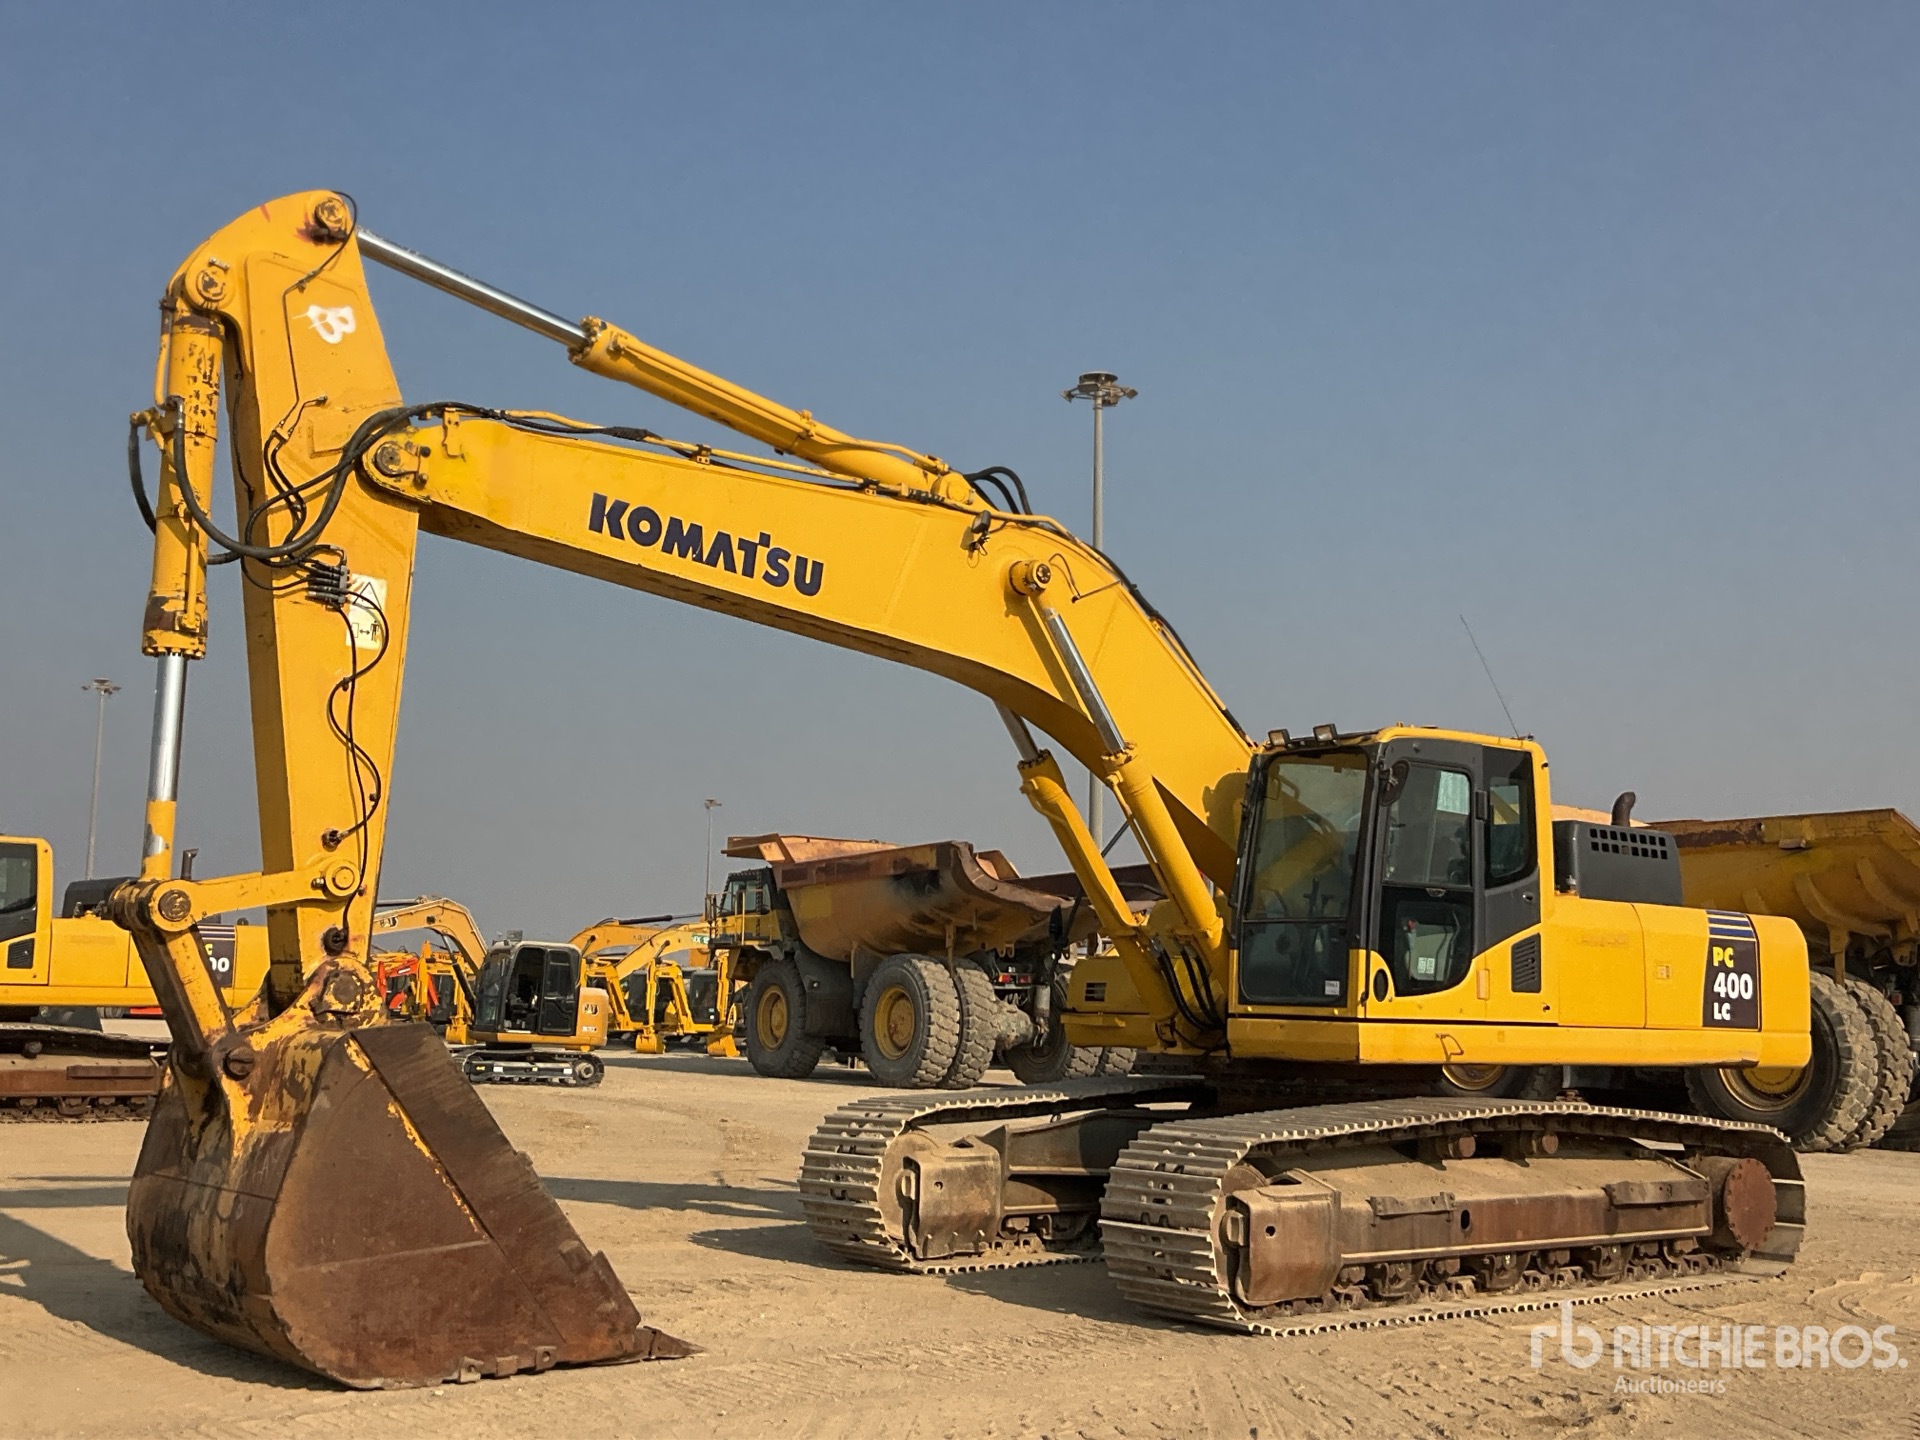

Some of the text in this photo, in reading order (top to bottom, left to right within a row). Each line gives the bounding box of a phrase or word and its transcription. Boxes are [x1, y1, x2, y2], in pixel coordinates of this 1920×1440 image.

[588, 492, 824, 597] KOMATSU
[1712, 947, 1734, 968] PC
[1713, 972, 1754, 1000] 400
[1713, 1002, 1731, 1021] LC
